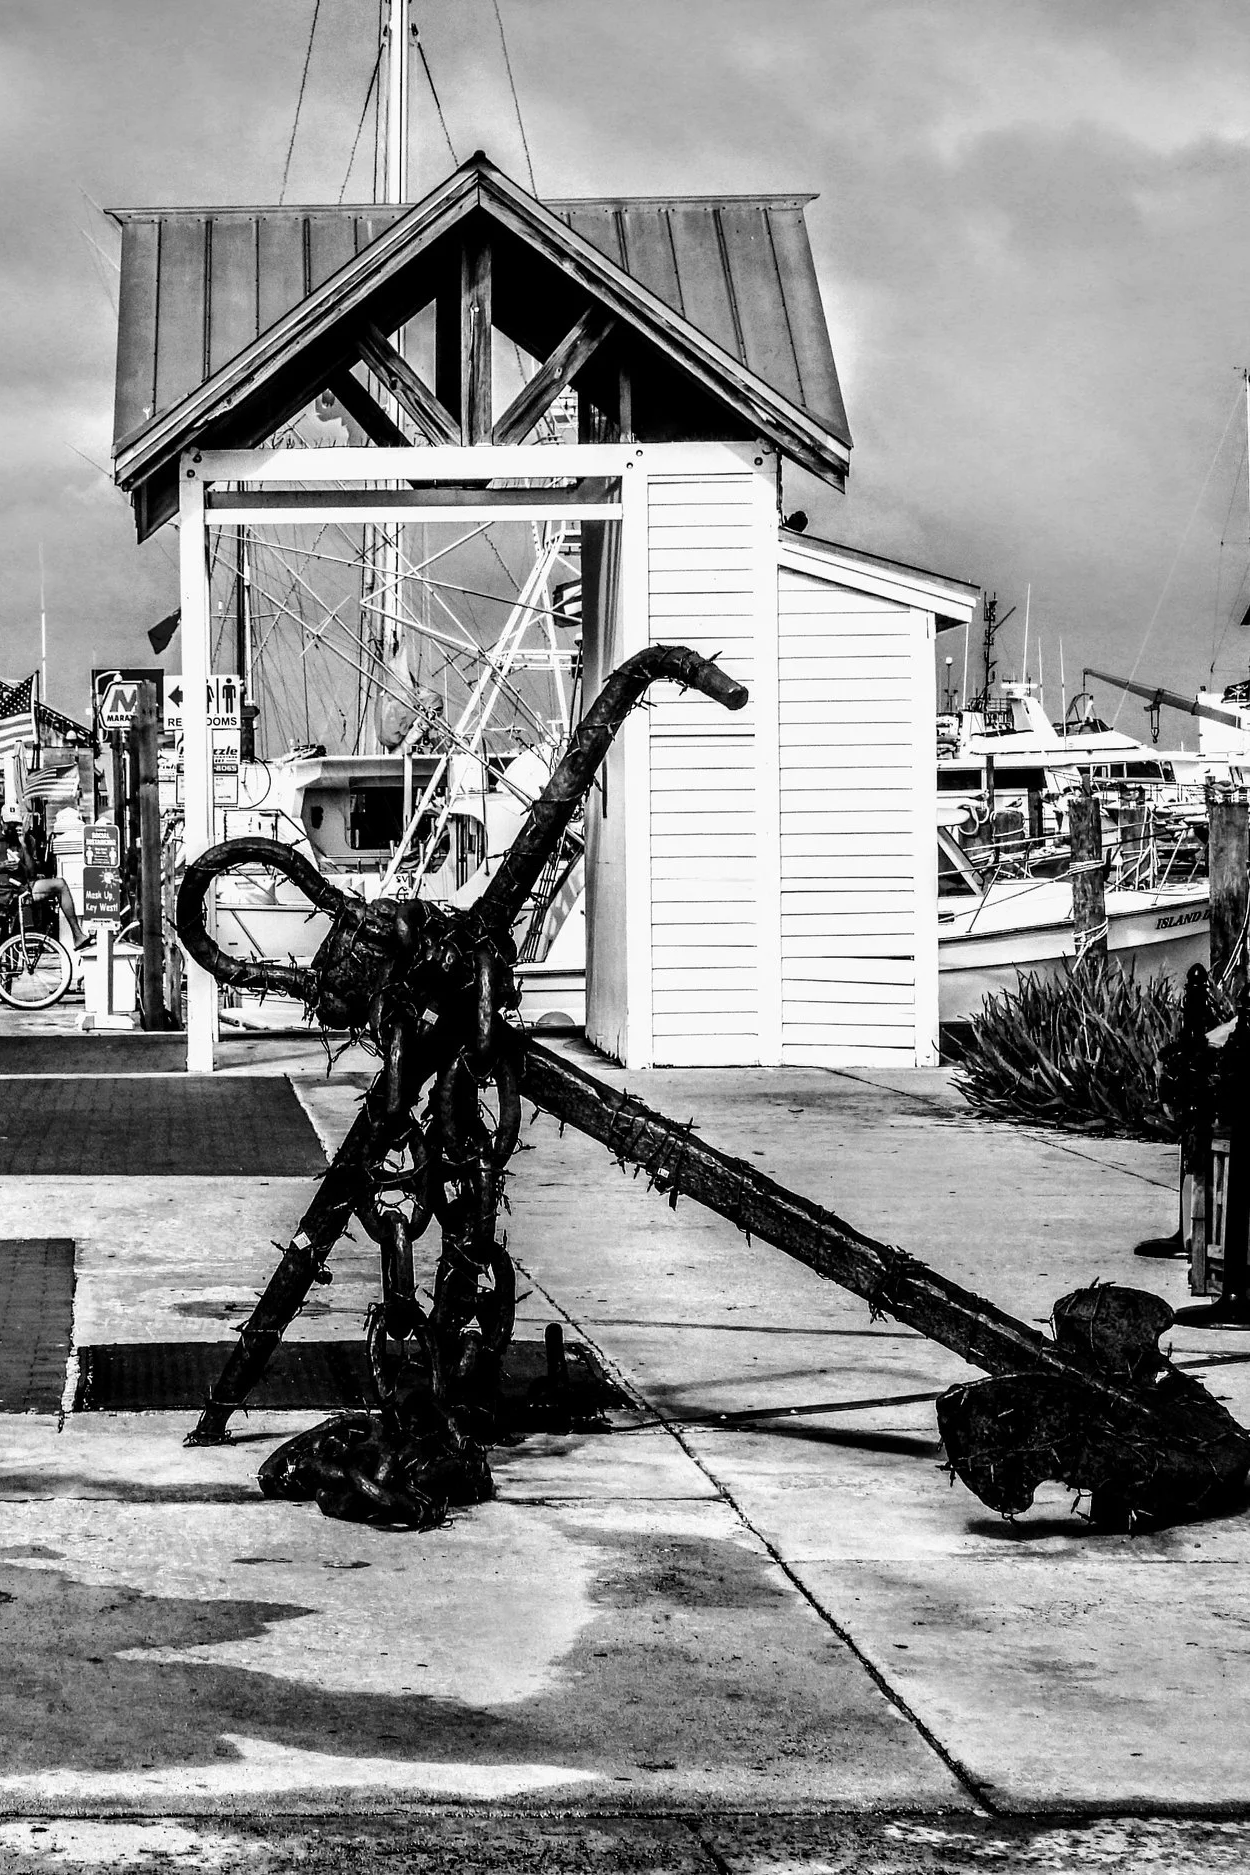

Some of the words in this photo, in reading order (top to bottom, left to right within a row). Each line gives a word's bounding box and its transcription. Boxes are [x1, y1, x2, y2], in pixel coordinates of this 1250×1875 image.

[106, 714, 131, 722] MARA
[85, 890, 102, 900] Mask
[85, 902, 98, 914] Key
[1155, 911, 1202, 930] ISLAND
